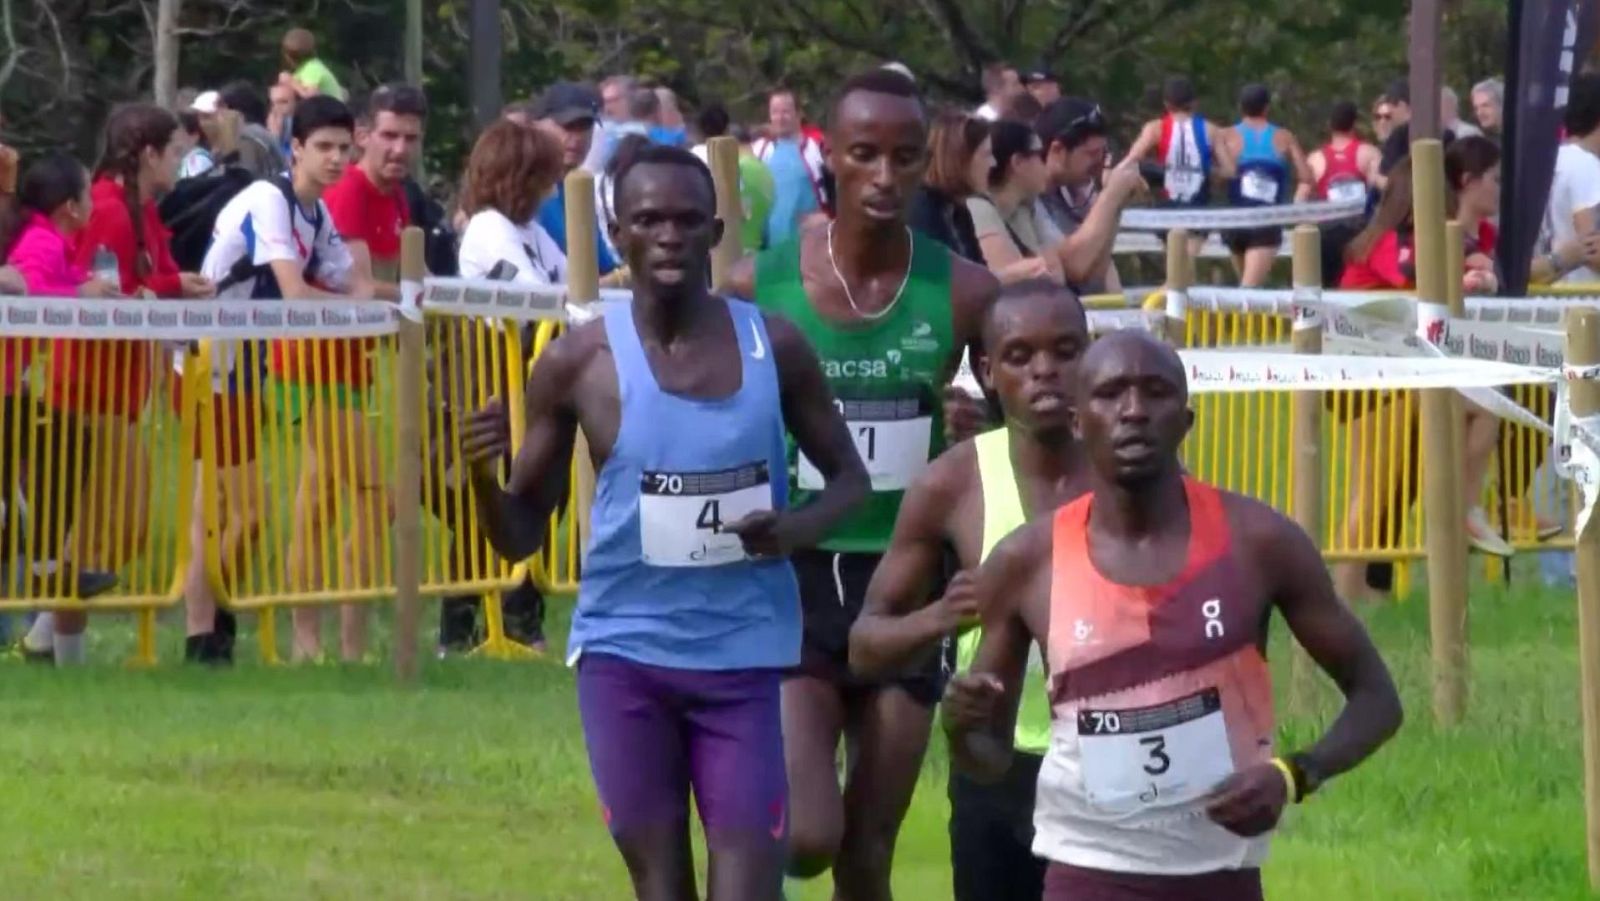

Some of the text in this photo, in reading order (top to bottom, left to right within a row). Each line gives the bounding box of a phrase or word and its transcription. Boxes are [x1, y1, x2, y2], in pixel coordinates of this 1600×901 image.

[820, 358, 887, 378] acsa
[655, 474, 683, 493] 70
[695, 499, 723, 535] 4
[1091, 712, 1121, 733] 70
[1139, 734, 1170, 775] 3
